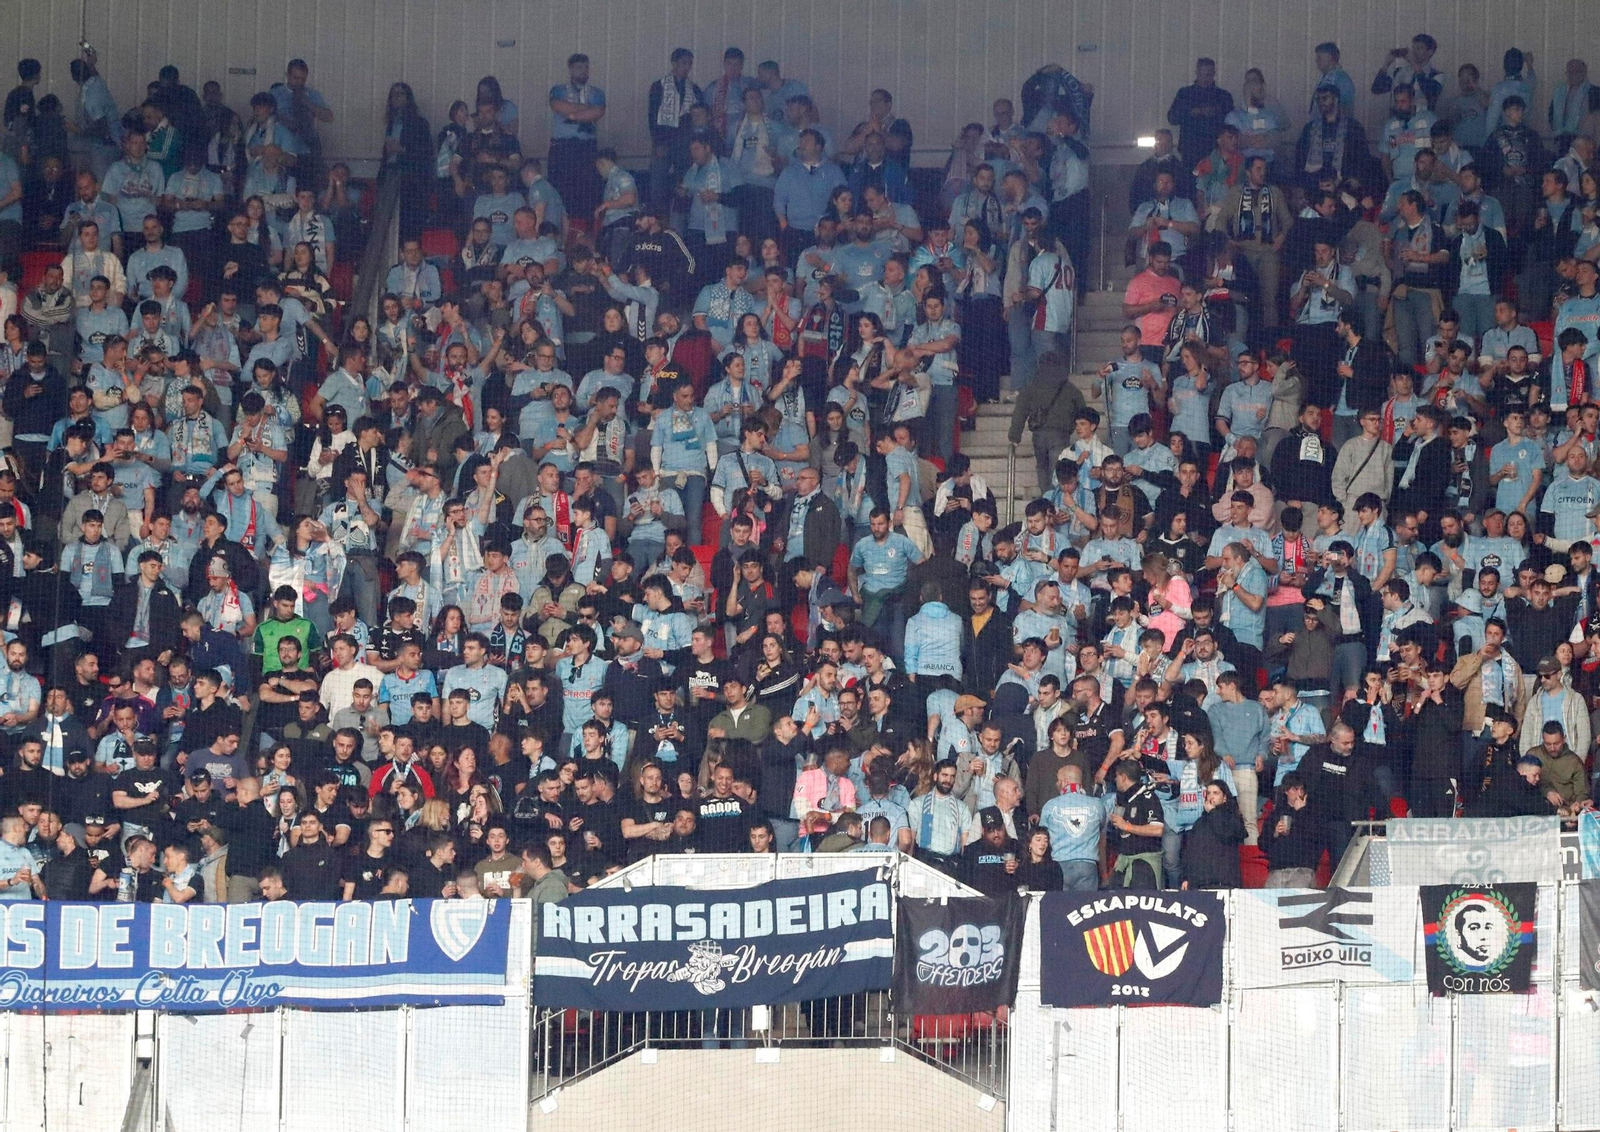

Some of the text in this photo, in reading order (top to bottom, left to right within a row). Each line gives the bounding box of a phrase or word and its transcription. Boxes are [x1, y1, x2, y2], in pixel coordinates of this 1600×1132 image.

[635, 242, 662, 252] adidas
[927, 663, 955, 672] ABANCA
[1393, 815, 1556, 842] ARRAIANO
[543, 883, 890, 943] ARRASADEIRA
[1067, 895, 1209, 928] ESKAPULATS
[0, 903, 45, 968] S
[60, 903, 135, 969] DE
[919, 924, 1005, 968] 203
[588, 944, 843, 993] Tropas Breogán
[1281, 947, 1372, 965] baixo ulla
[135, 970, 210, 1007] Celta
[218, 969, 286, 1008] Vigo
